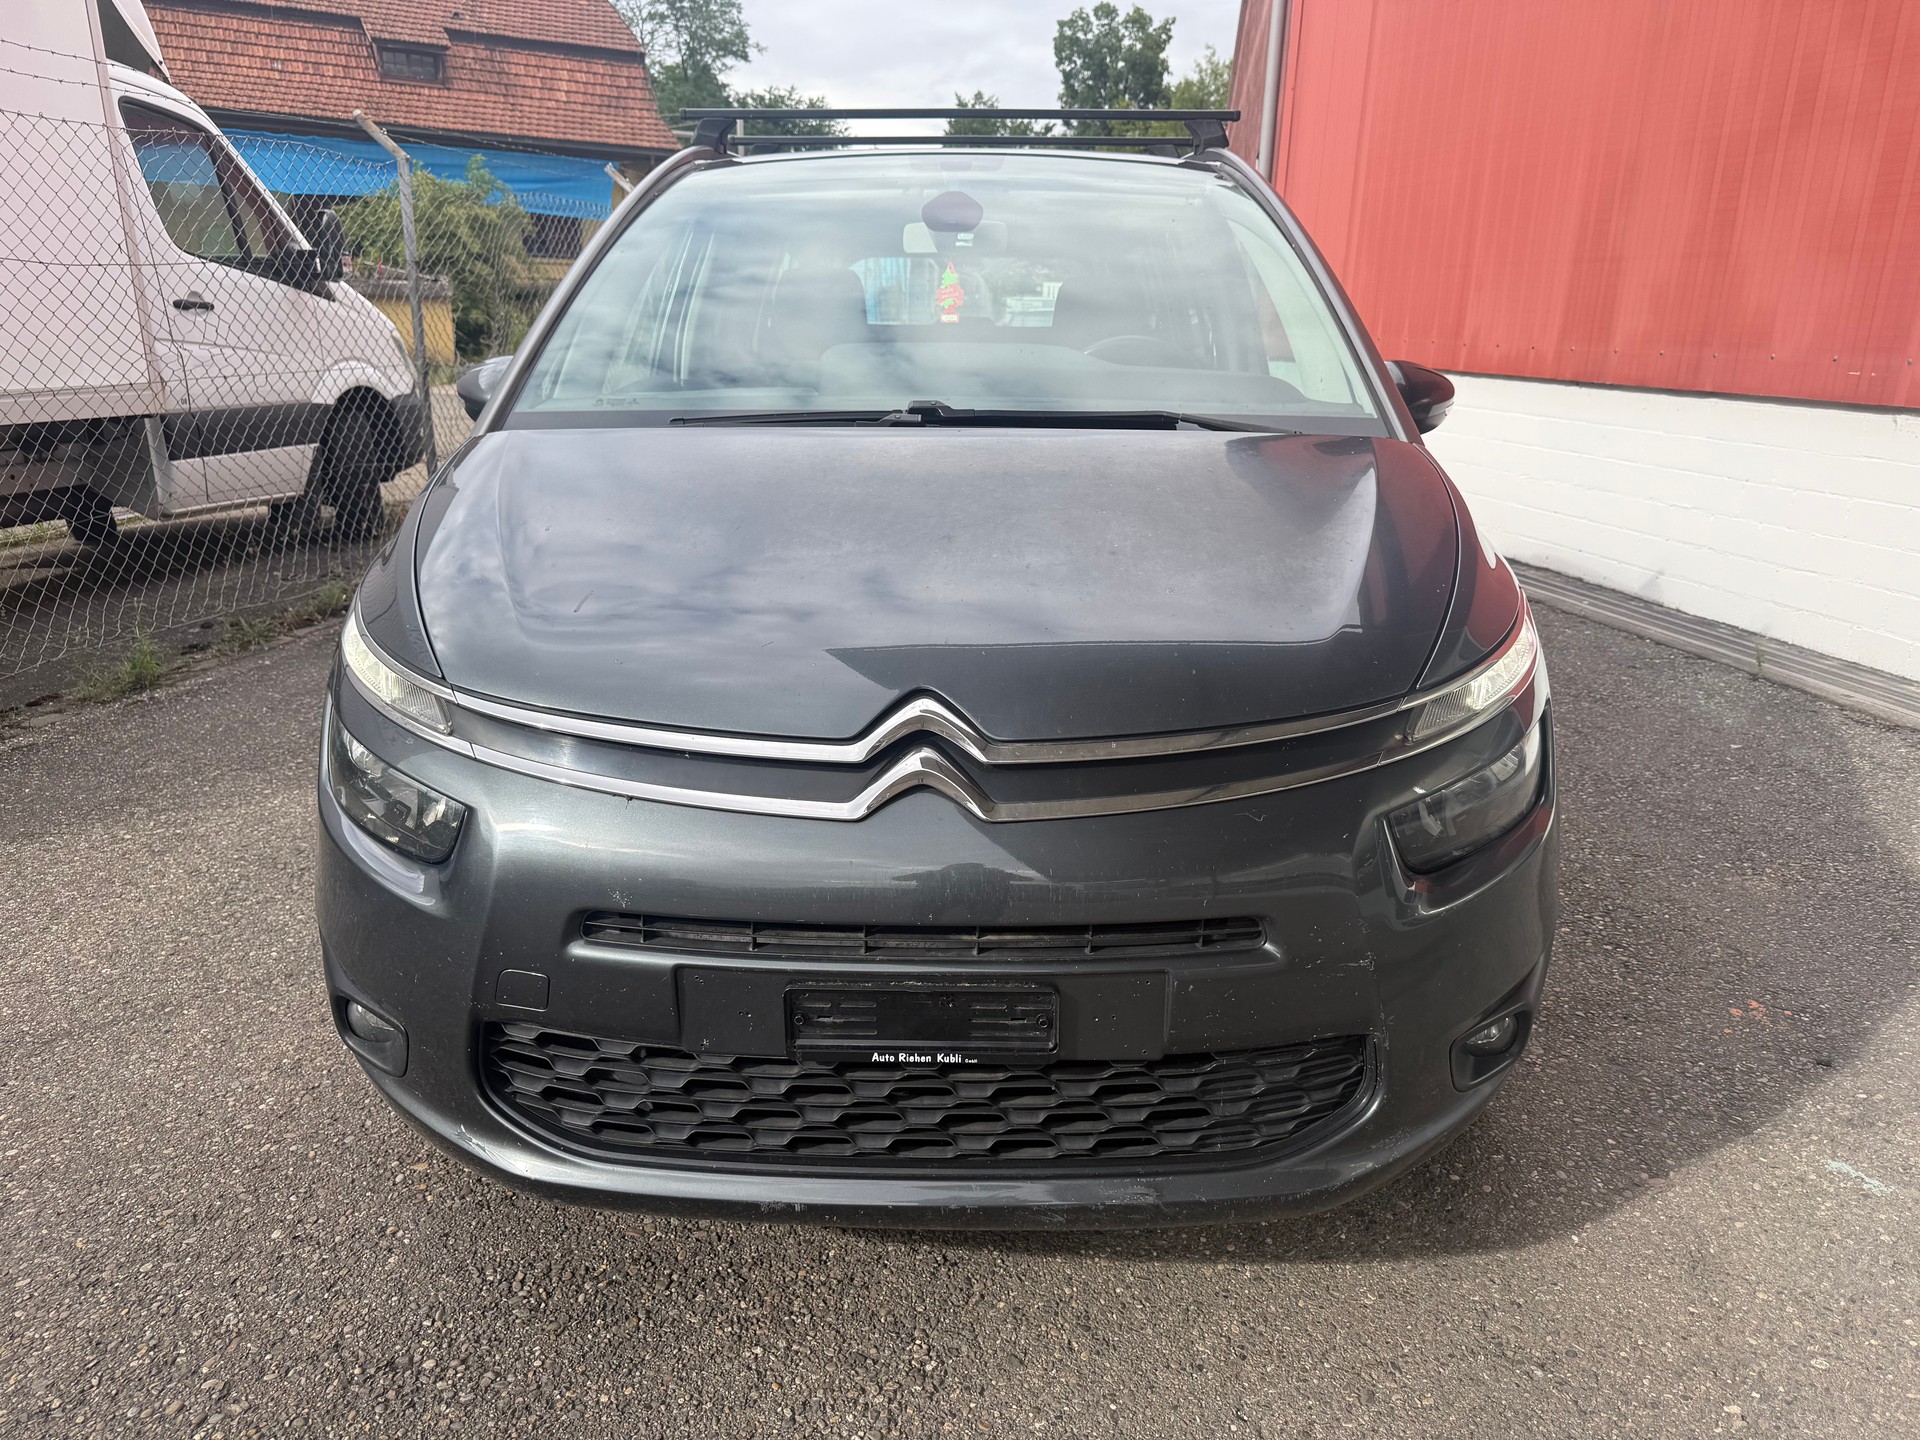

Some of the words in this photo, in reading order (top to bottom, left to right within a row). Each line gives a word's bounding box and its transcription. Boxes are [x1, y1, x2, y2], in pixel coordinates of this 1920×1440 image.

[871, 1052, 895, 1062] Auto
[898, 1053, 932, 1063] Riehen
[936, 1053, 962, 1064] Kubli
